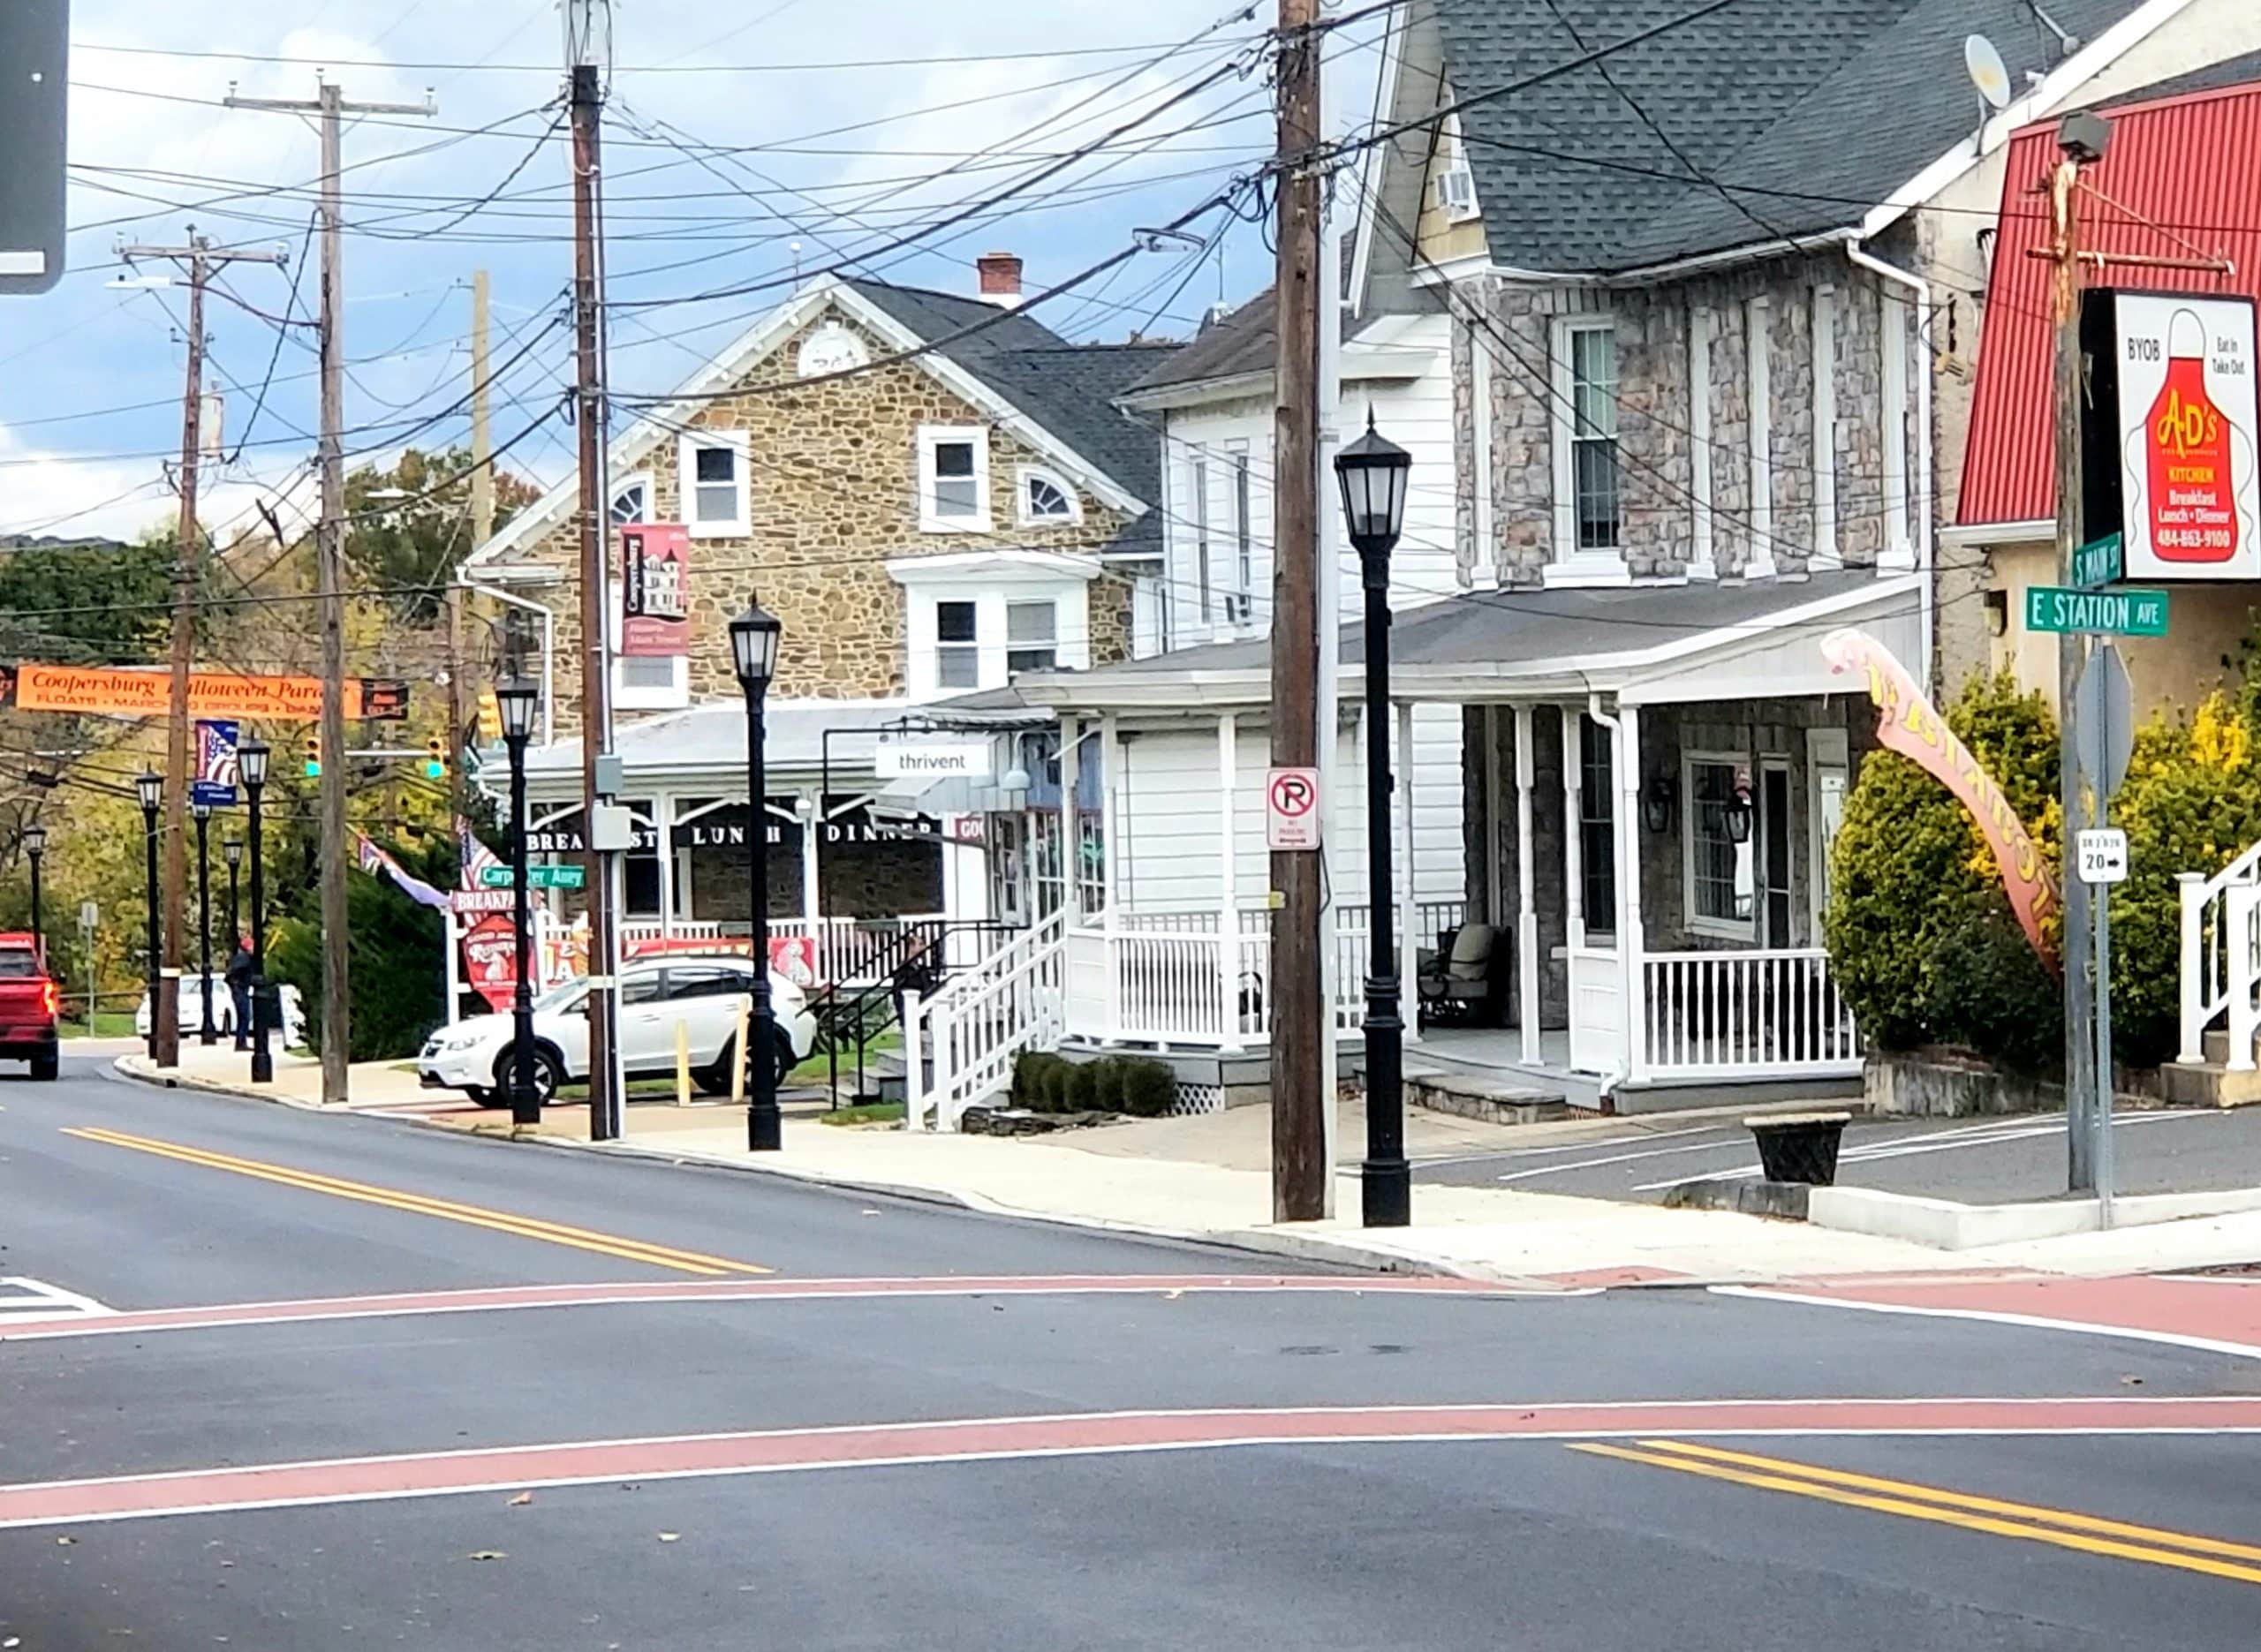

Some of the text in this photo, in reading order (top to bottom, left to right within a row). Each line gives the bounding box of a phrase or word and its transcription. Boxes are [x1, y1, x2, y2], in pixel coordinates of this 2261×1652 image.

[2128, 337, 2161, 361] BYOB
[2217, 336, 2230, 353] Eat
[2212, 359, 2245, 375] Take Out
[2168, 466, 2215, 483] KITCHEN
[2168, 489, 2217, 506] Breakfast
[2158, 508, 2231, 523] Lunch Dinner
[2157, 529, 2231, 548] 484-863-9100
[2076, 554, 2084, 587] S
[2085, 546, 2108, 582] MAIN
[2032, 592, 2159, 630] E STATION AVE
[33, 671, 156, 698] Coopersburg
[167, 680, 268, 700] lloween
[899, 753, 965, 769] thrivent
[526, 831, 657, 851] BREAST
[692, 826, 781, 845] LUNH
[2086, 854, 2105, 870] 20
[482, 867, 545, 886] Carpter
[457, 891, 516, 911] BREAKFA
